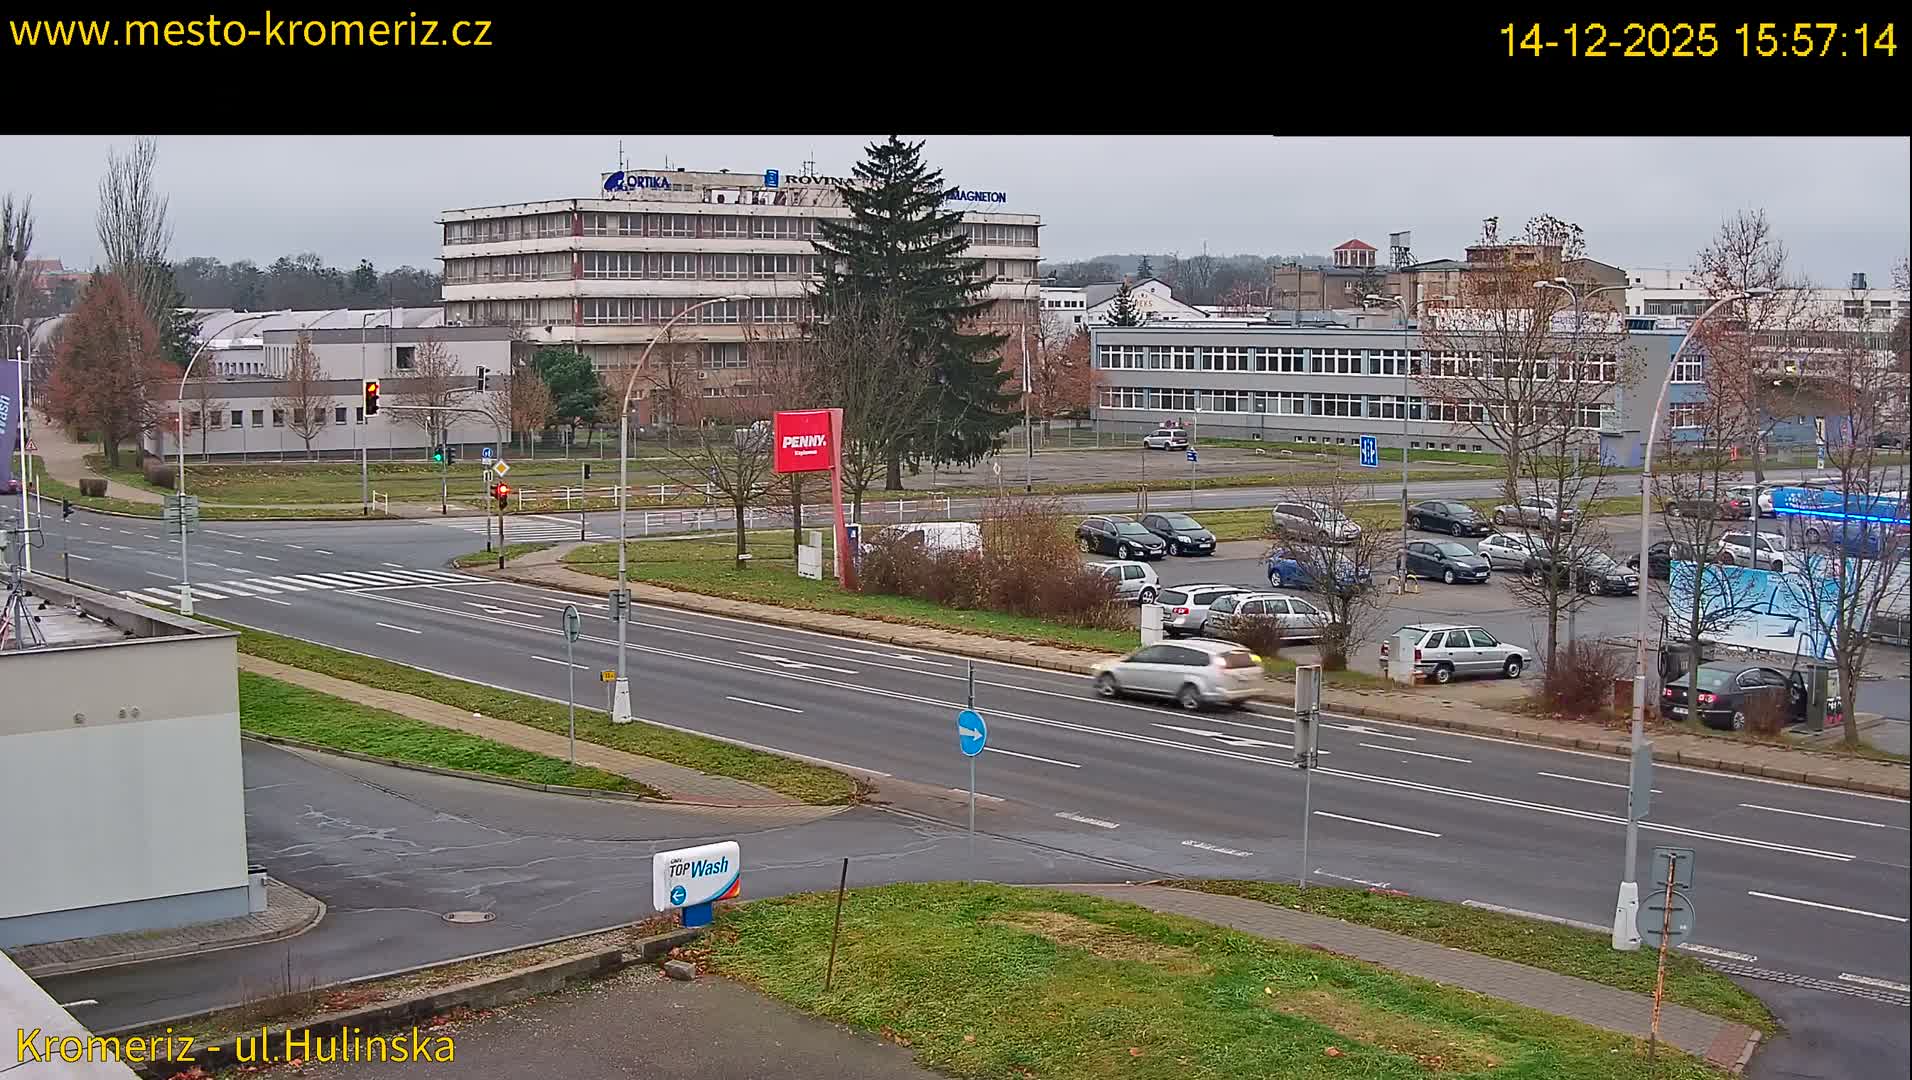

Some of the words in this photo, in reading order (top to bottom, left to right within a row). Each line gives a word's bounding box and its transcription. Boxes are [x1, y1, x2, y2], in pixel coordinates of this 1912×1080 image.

[627, 175, 671, 189] ORTIKA
[785, 175, 855, 186] ROVINA
[670, 862, 691, 878] TOP
[691, 856, 729, 878] Wash
